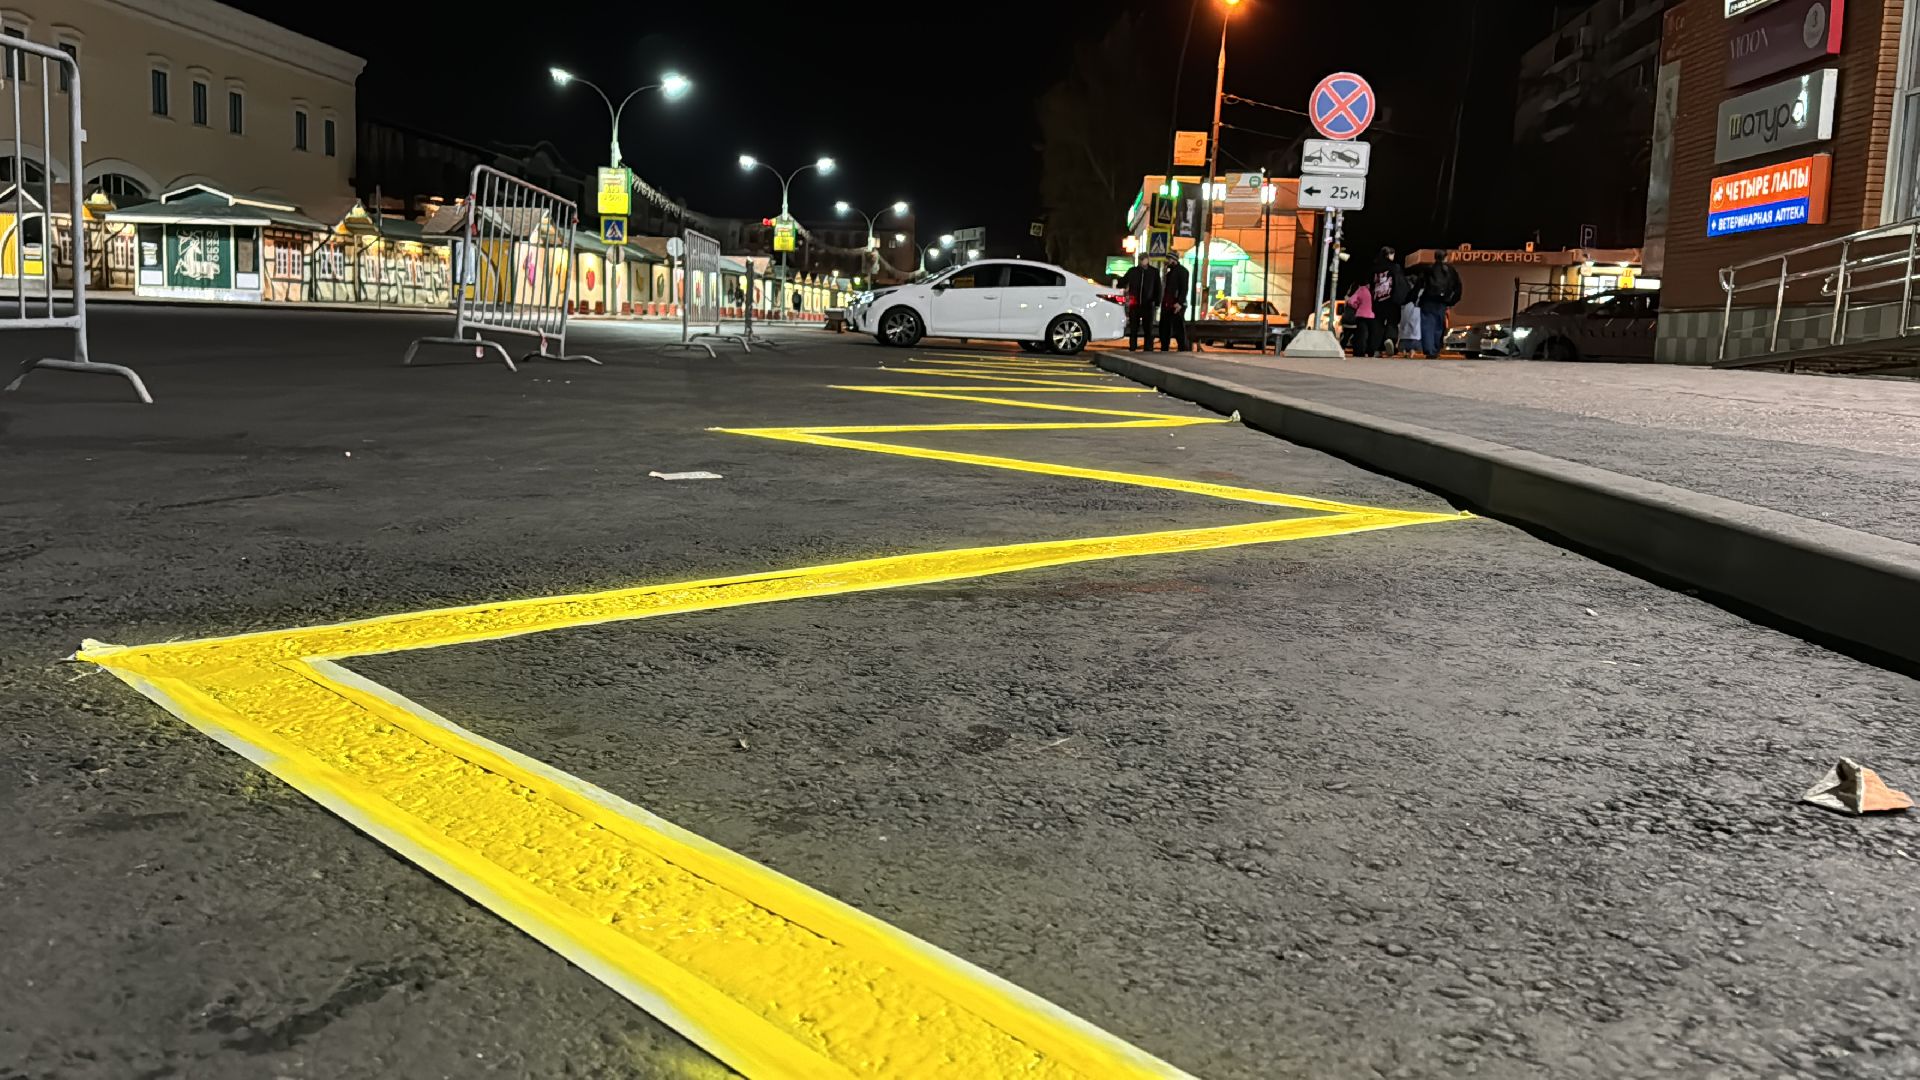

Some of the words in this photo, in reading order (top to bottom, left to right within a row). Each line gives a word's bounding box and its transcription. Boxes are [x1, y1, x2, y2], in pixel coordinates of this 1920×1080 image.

[1726, 175, 1769, 201] ЧЕТЫРЕ
[1770, 166, 1809, 193] ЛАПЫ
[1718, 210, 1773, 231] ВЕТЕРИНАРНАЯ
[1774, 205, 1805, 222] АПТЕКА
[1451, 251, 1541, 263] МОРОЖЕНОЕ
